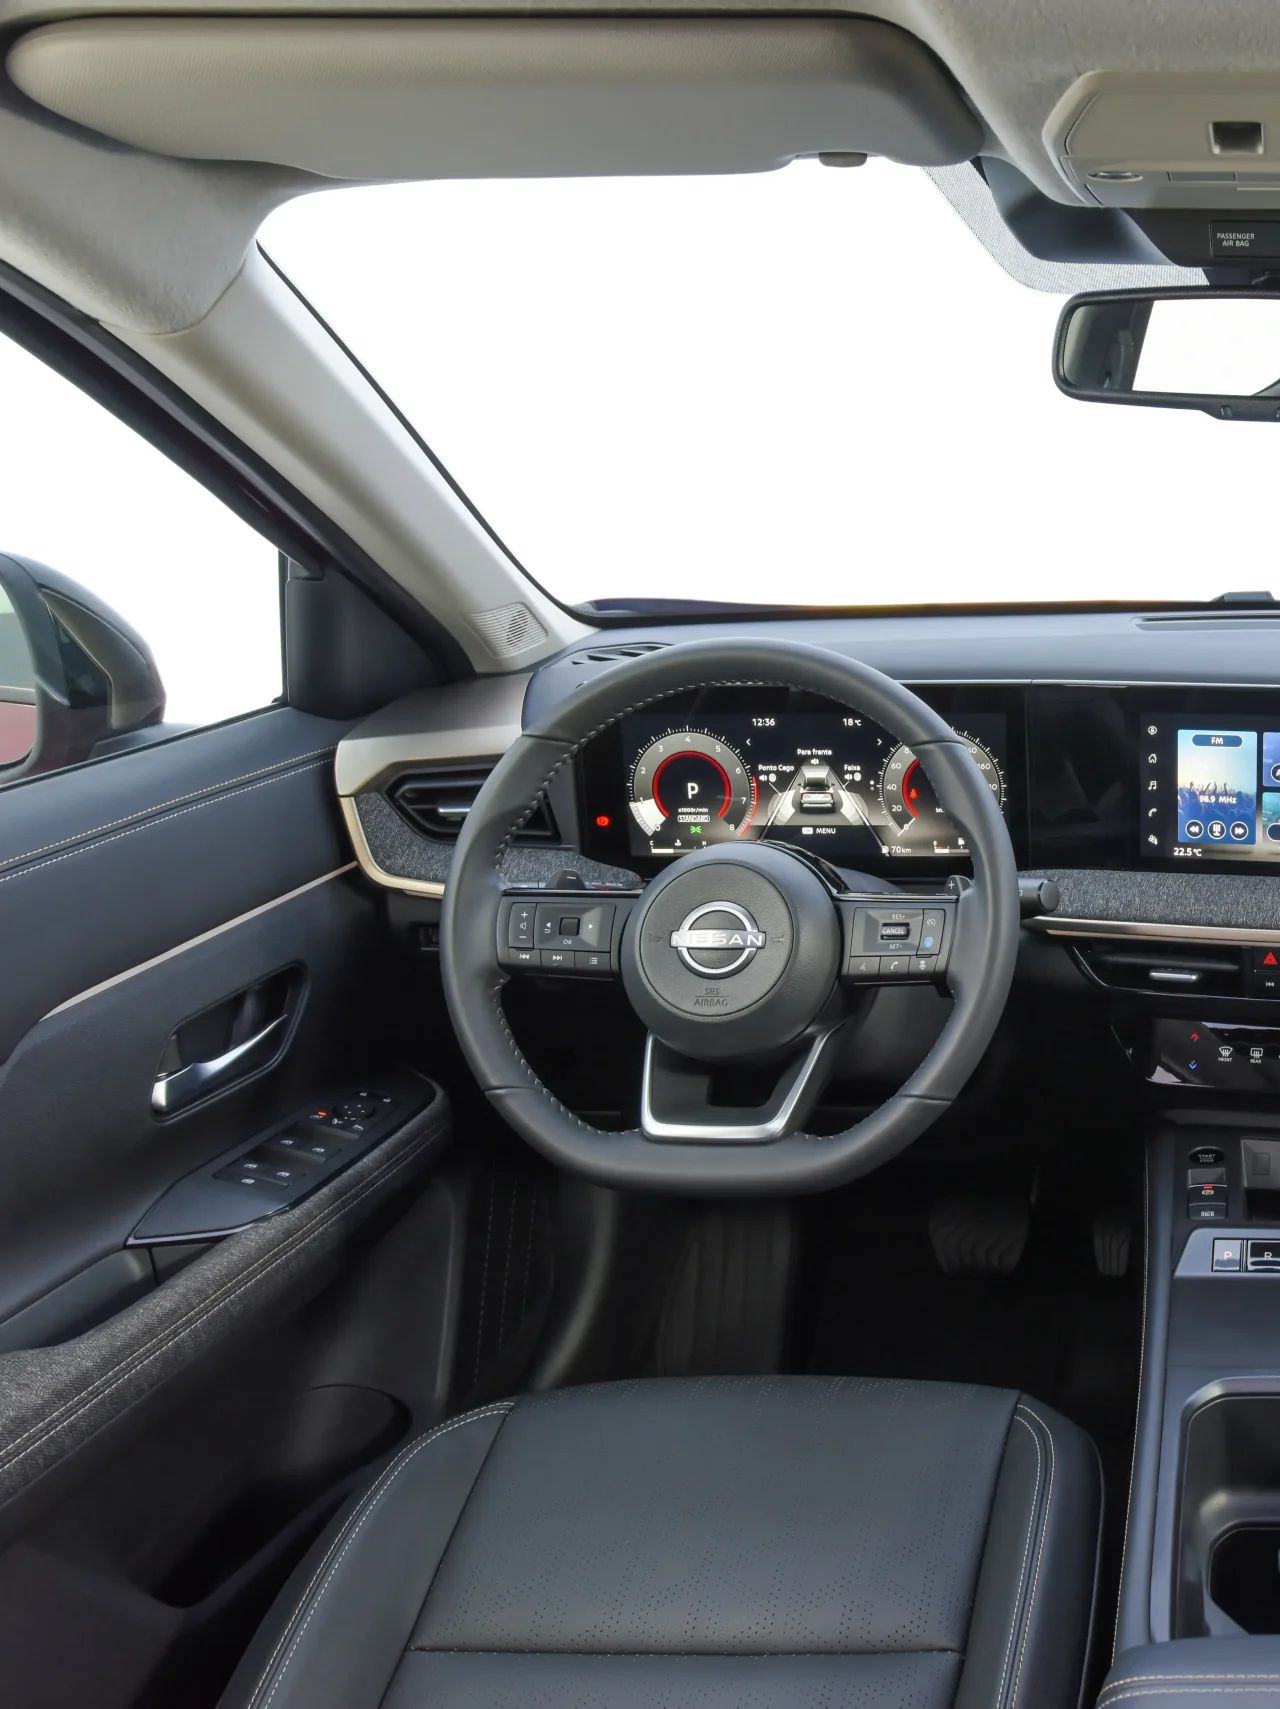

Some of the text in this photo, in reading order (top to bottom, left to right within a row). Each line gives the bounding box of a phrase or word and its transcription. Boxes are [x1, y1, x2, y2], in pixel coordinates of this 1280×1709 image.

[1216, 232, 1255, 240] PASSENGER
[752, 718, 776, 726] 12:36
[1211, 737, 1224, 745] FM
[891, 762, 902, 770] 60
[687, 782, 699, 799] P
[1199, 795, 1237, 804] 98.9 MHz
[672, 932, 763, 946] NISSAN
[704, 987, 720, 996] SRS
[693, 998, 728, 1007] AIRBAG
[1224, 1251, 1232, 1259] P
[1264, 1251, 1273, 1259] R
